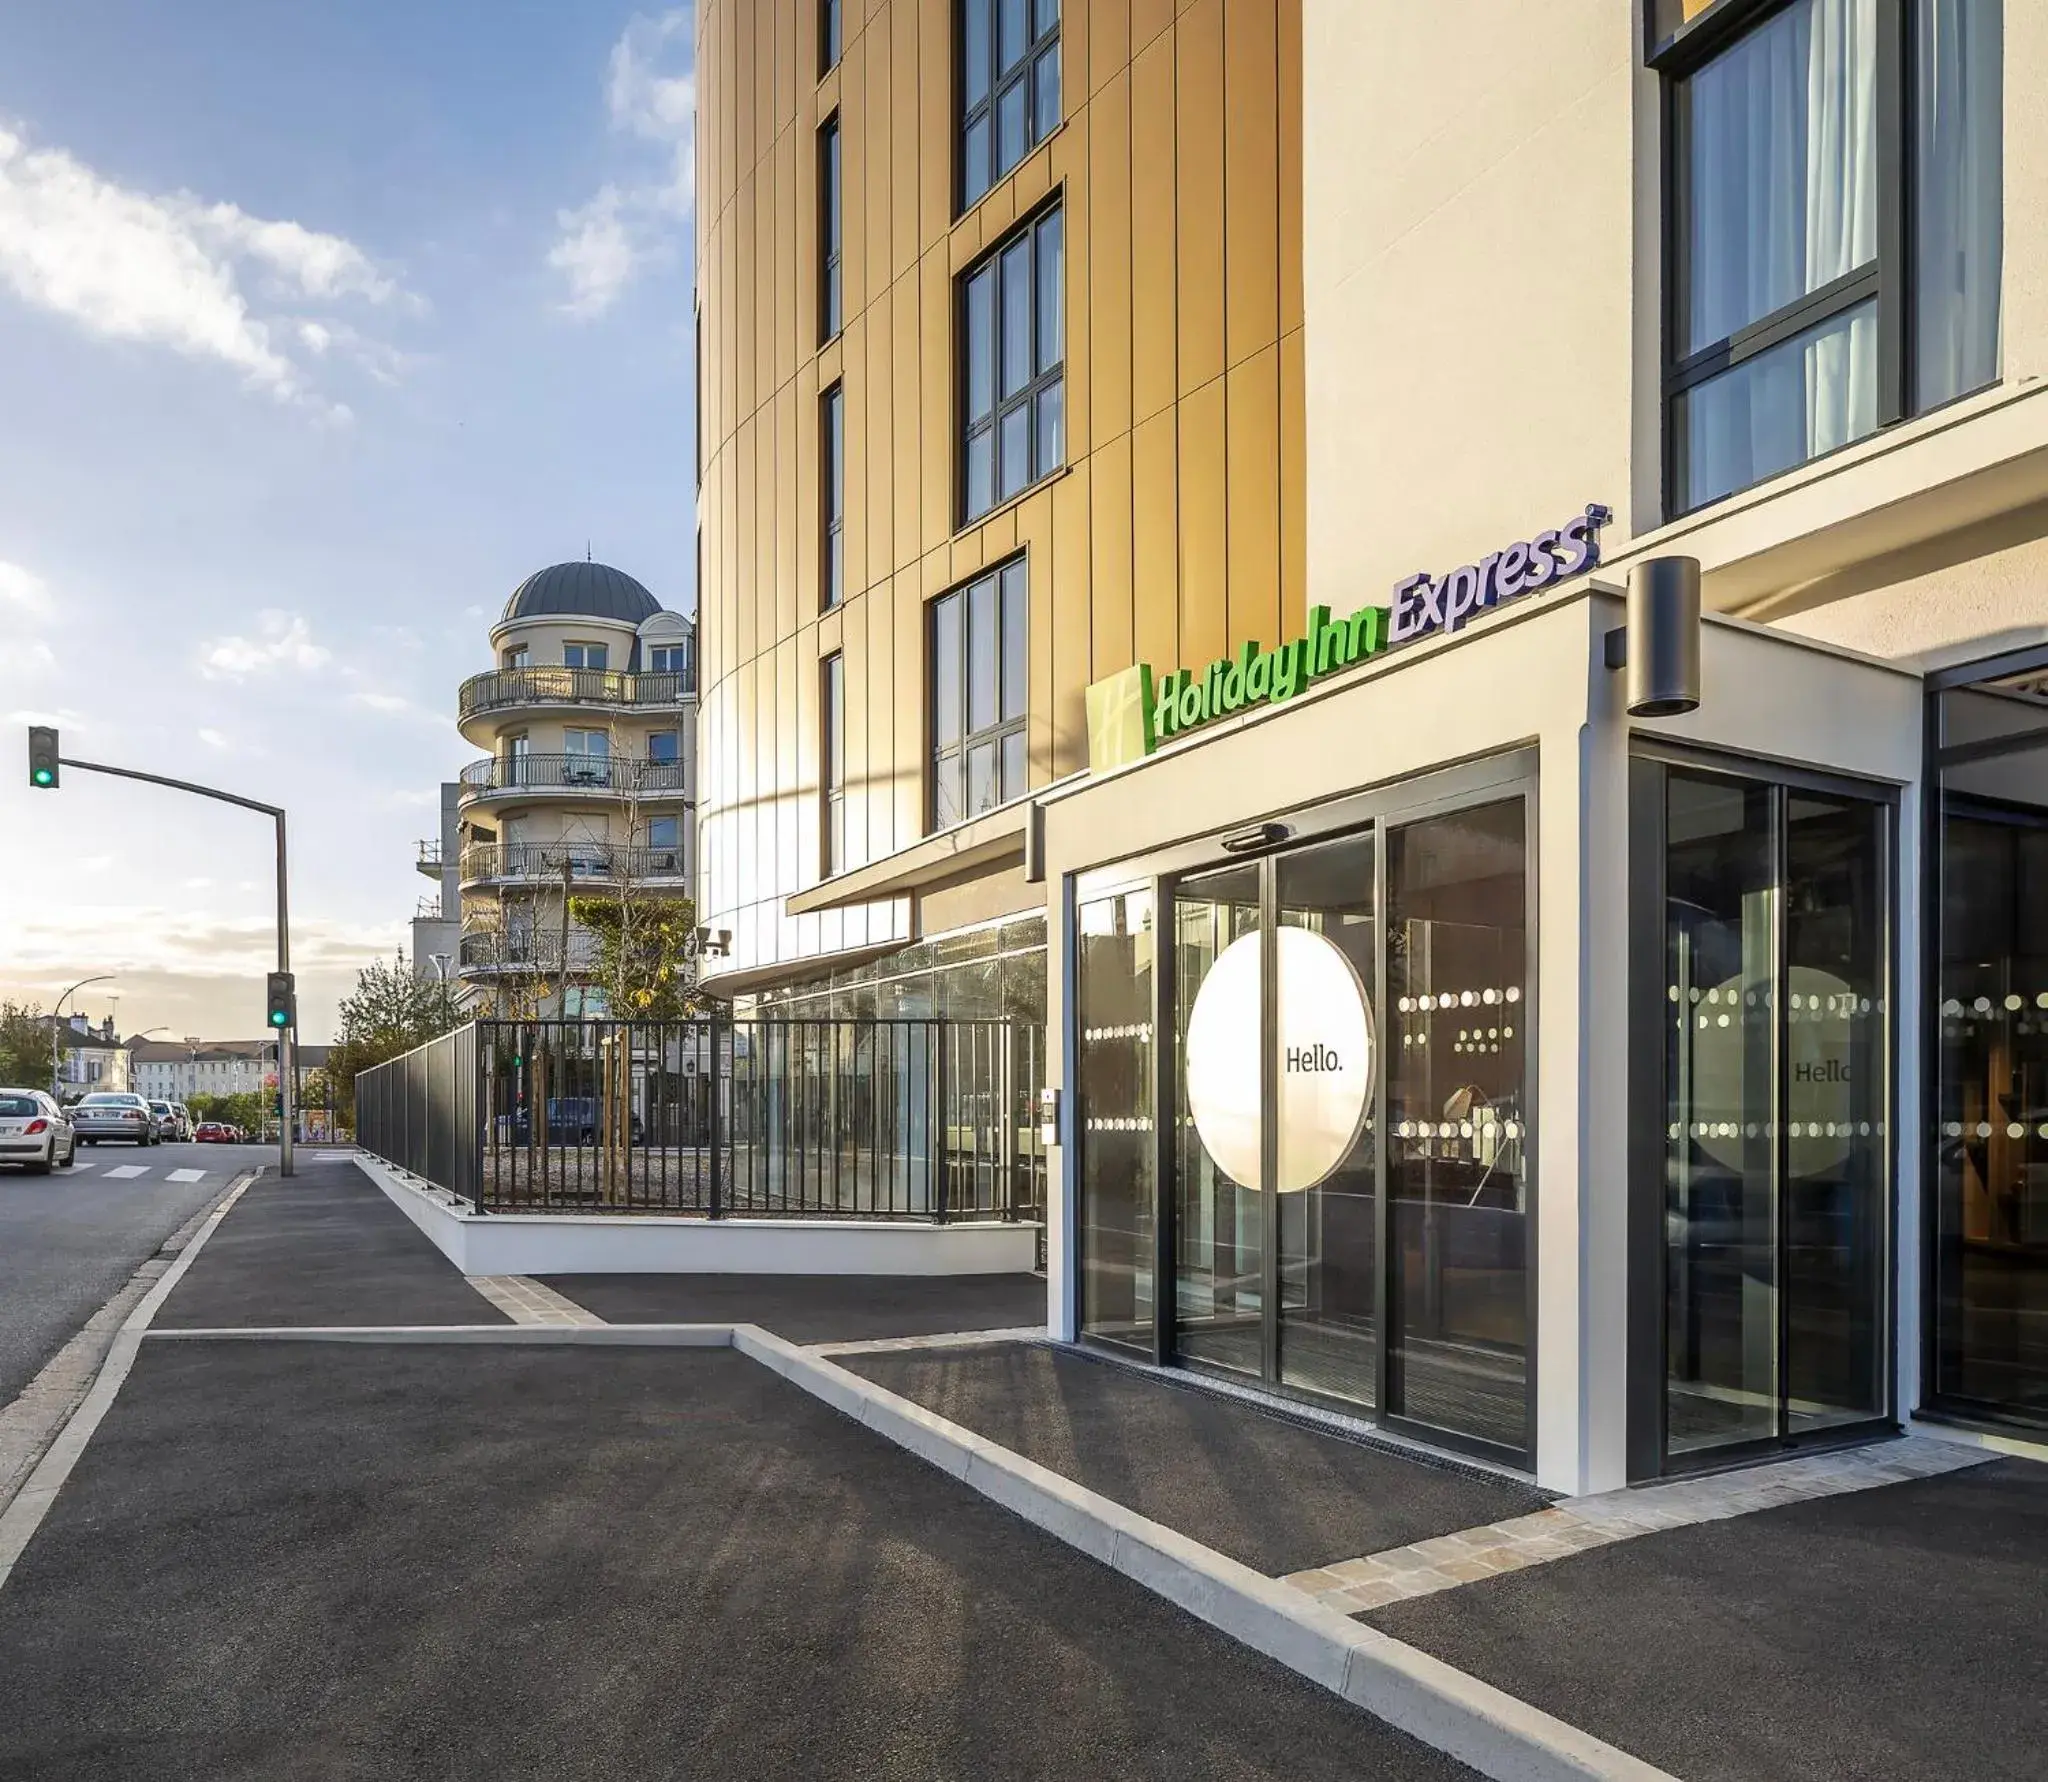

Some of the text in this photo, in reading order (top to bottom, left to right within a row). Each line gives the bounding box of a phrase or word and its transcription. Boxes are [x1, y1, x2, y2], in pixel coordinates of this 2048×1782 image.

[1153, 641, 1306, 737] Holiday
[1306, 604, 1391, 677] Inn
[1388, 512, 1600, 643] Express
[1286, 1044, 1343, 1073] Hello.
